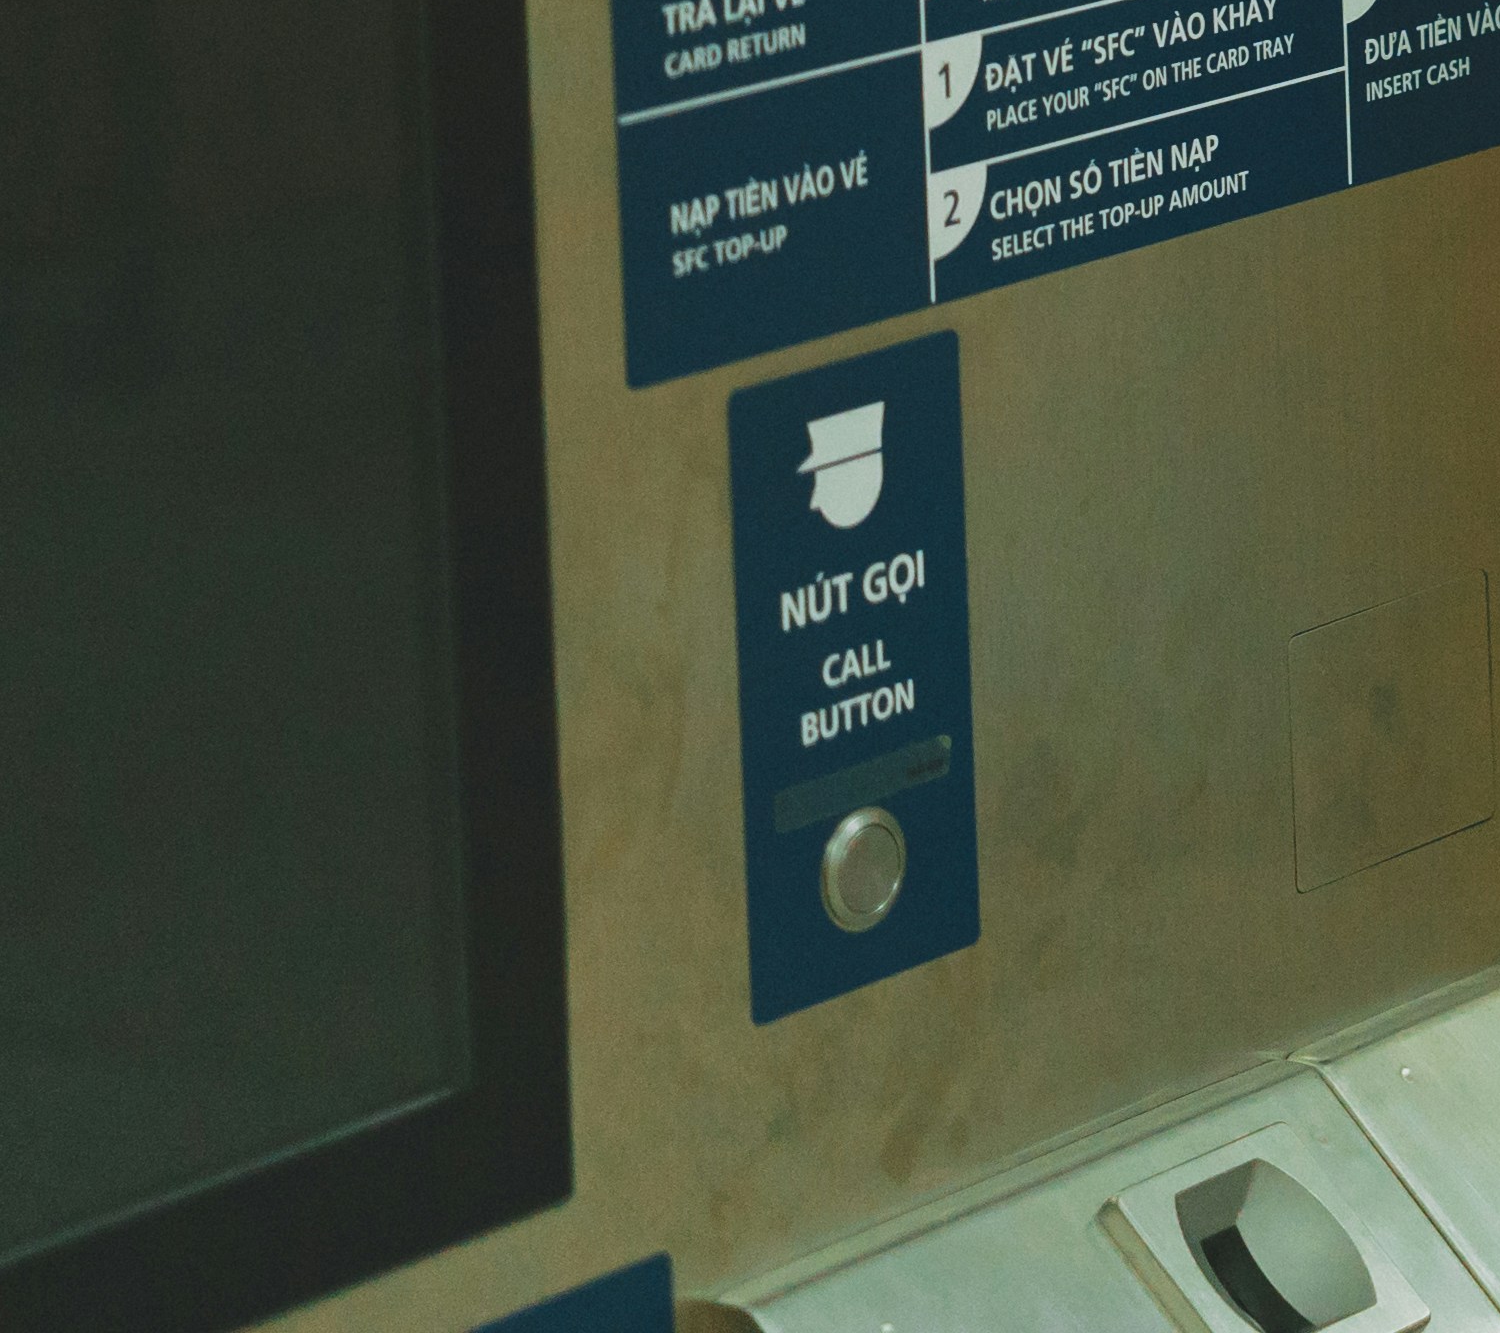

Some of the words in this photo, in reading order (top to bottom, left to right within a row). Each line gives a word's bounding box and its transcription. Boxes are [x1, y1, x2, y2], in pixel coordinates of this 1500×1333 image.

[664, 42, 723, 79] CARD
[726, 23, 807, 64] RETURN
[985, 52, 1036, 93] ĐẶT
[1043, 38, 1073, 77] VÉ
[1152, 11, 1205, 48] VÀO
[1364, 30, 1412, 65] ĐƯA
[1416, 13, 1462, 51] TIỀN
[938, 62, 952, 99] 1
[986, 100, 1037, 131] PLACE
[1042, 86, 1089, 117] YOUR
[1142, 65, 1167, 92] ON
[1171, 55, 1202, 83] THE
[1206, 44, 1250, 75] CARD
[1253, 33, 1294, 59] TRAY
[1366, 69, 1422, 102] INSERT
[1426, 56, 1471, 85] CASH
[669, 194, 720, 237] NẠP
[724, 176, 779, 220] TIỀN
[783, 163, 835, 207] VÀO
[839, 149, 869, 190] VÉ
[943, 188, 961, 227] 2
[989, 175, 1063, 220] CHỌN
[1069, 158, 1102, 199] SỐ
[1108, 147, 1163, 188] TIỀN
[1170, 133, 1219, 172] NẠP
[991, 224, 1054, 261] SELECT
[1059, 214, 1095, 241] THE
[1098, 194, 1164, 230] TOP-UP
[1168, 170, 1250, 212] AMOUNT
[672, 244, 709, 278] SFC
[713, 224, 788, 267] TOP-UP
[780, 572, 853, 632] NÚT
[863, 549, 926, 603] GỌI
[822, 638, 892, 688] CALL
[800, 679, 916, 747] BUTTON
